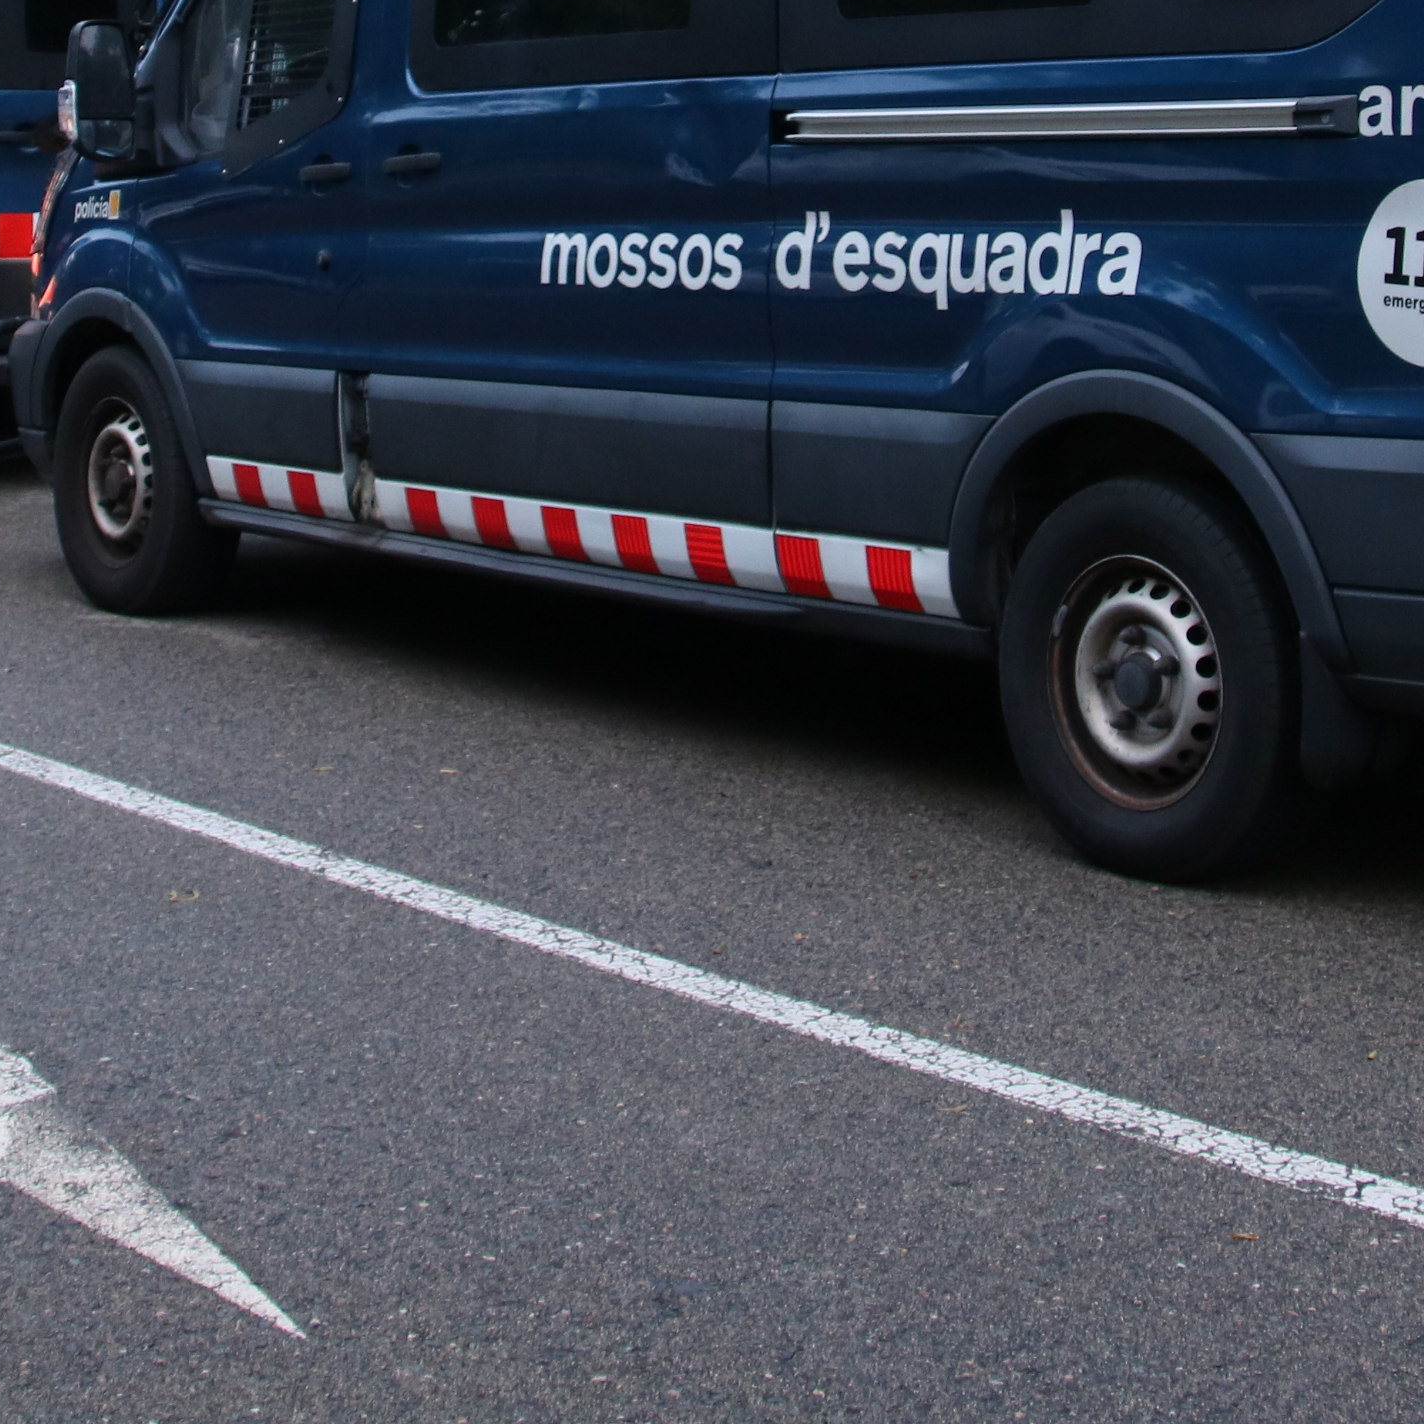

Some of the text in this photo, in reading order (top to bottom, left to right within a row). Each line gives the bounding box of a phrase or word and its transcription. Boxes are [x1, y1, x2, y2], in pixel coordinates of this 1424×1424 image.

[74, 195, 109, 223] policia
[540, 209, 1143, 310] mossos d'esquadra
